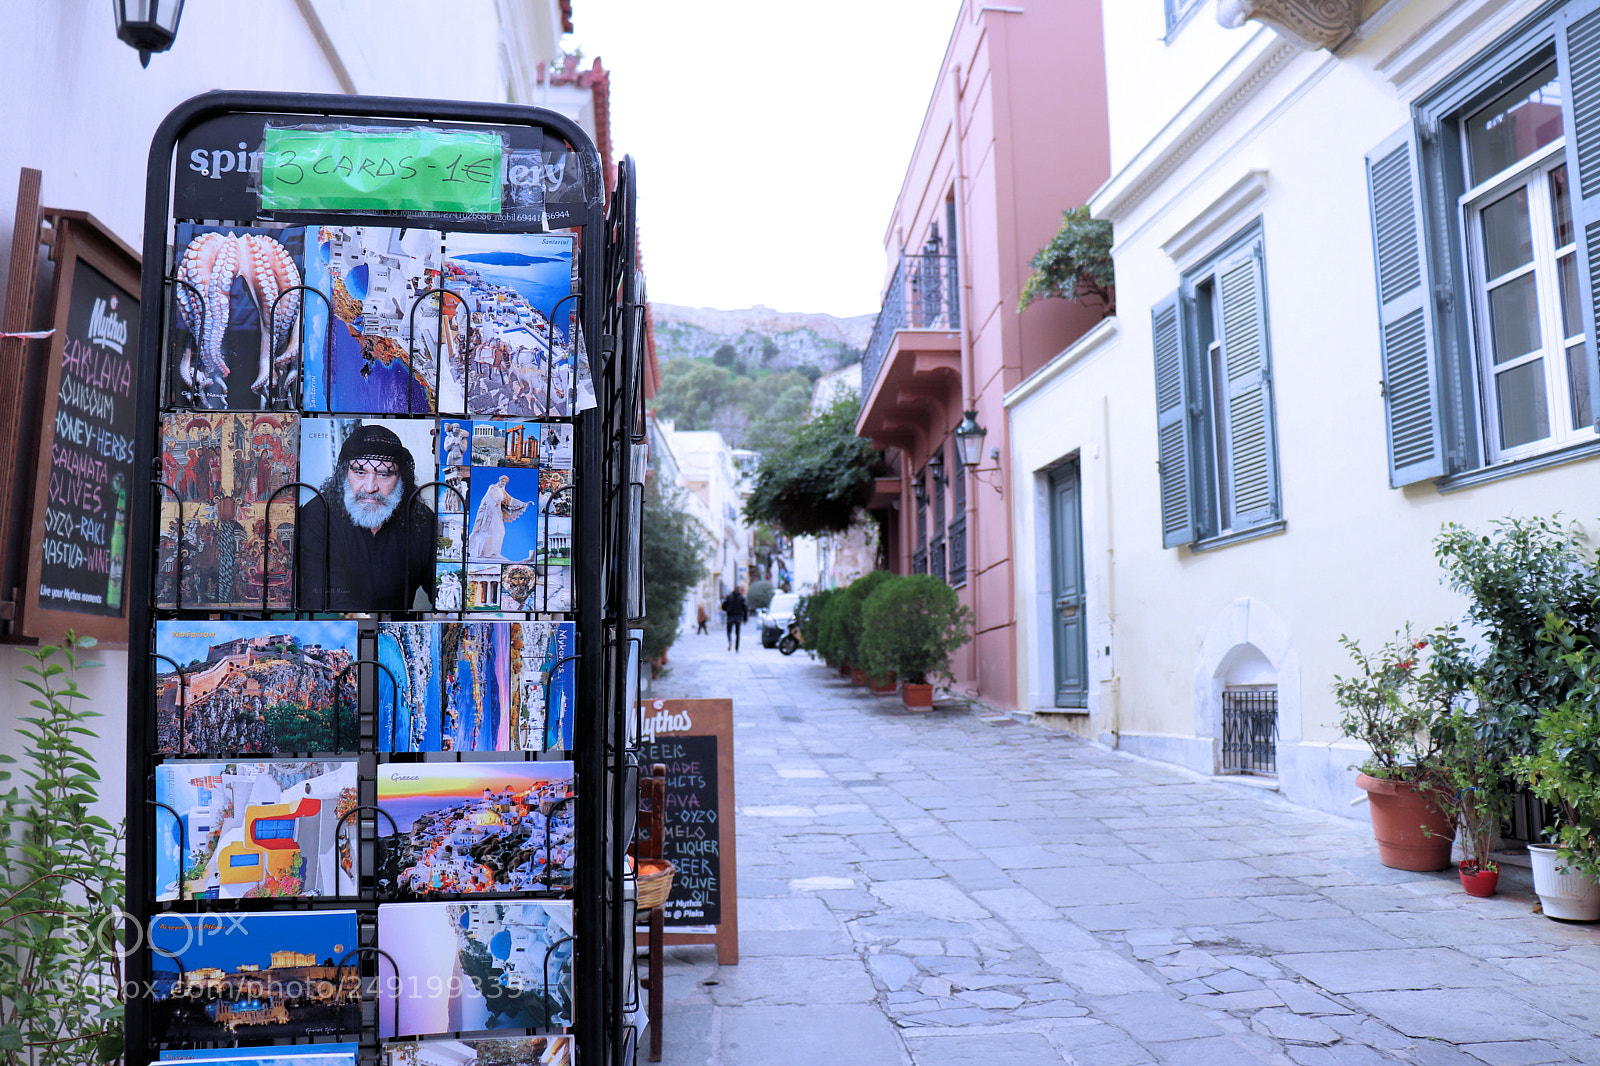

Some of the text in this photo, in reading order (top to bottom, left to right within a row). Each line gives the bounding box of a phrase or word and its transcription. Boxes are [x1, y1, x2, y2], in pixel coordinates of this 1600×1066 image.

[276, 150, 304, 185] 3
[312, 154, 417, 180] CARDS
[87, 296, 128, 350] Mythos
[58, 373, 114, 426] OUKOUM
[309, 374, 317, 409] Santorini
[48, 471, 102, 514] OLIVES
[40, 583, 51, 597] Live
[63, 587, 81, 602] Mythos
[637, 743, 687, 760] REEK
[390, 772, 420, 783] Greece
[671, 857, 714, 877] BEER
